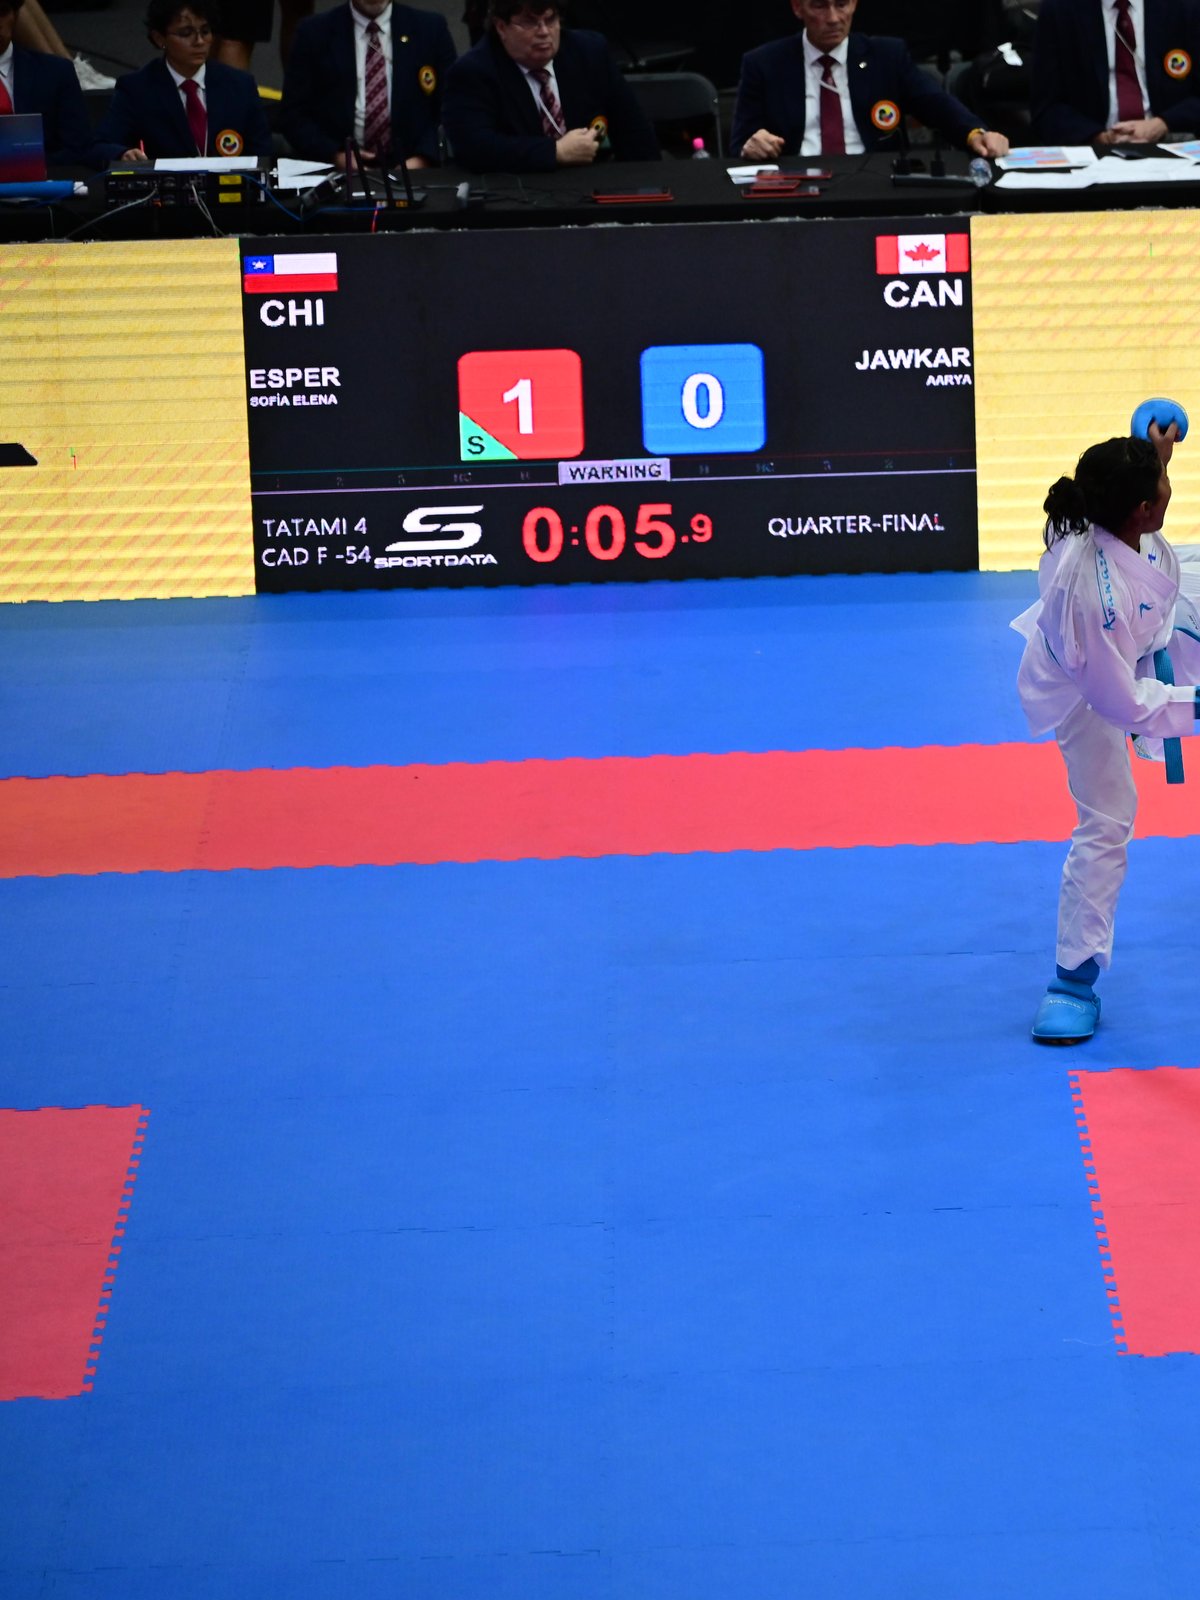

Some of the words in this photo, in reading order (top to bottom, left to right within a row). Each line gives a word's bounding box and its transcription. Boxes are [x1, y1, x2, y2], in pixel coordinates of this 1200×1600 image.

[883, 279, 964, 308] CAN
[259, 298, 325, 327] CHI
[855, 347, 971, 371] JAWKAR
[249, 366, 342, 390] ESPER
[926, 373, 972, 387] AARYA
[292, 393, 338, 407] ELENA
[503, 378, 534, 435] 1
[681, 372, 725, 430] 0
[466, 435, 486, 455] S
[568, 463, 663, 481] WARNING
[262, 517, 348, 538] TATAMI
[353, 516, 368, 535] 4
[768, 513, 945, 538] QUARTER-FINAL
[261, 547, 310, 567] CAD
[317, 546, 328, 565] F
[335, 545, 372, 565] -54
[373, 553, 498, 569] SPORTDATA
